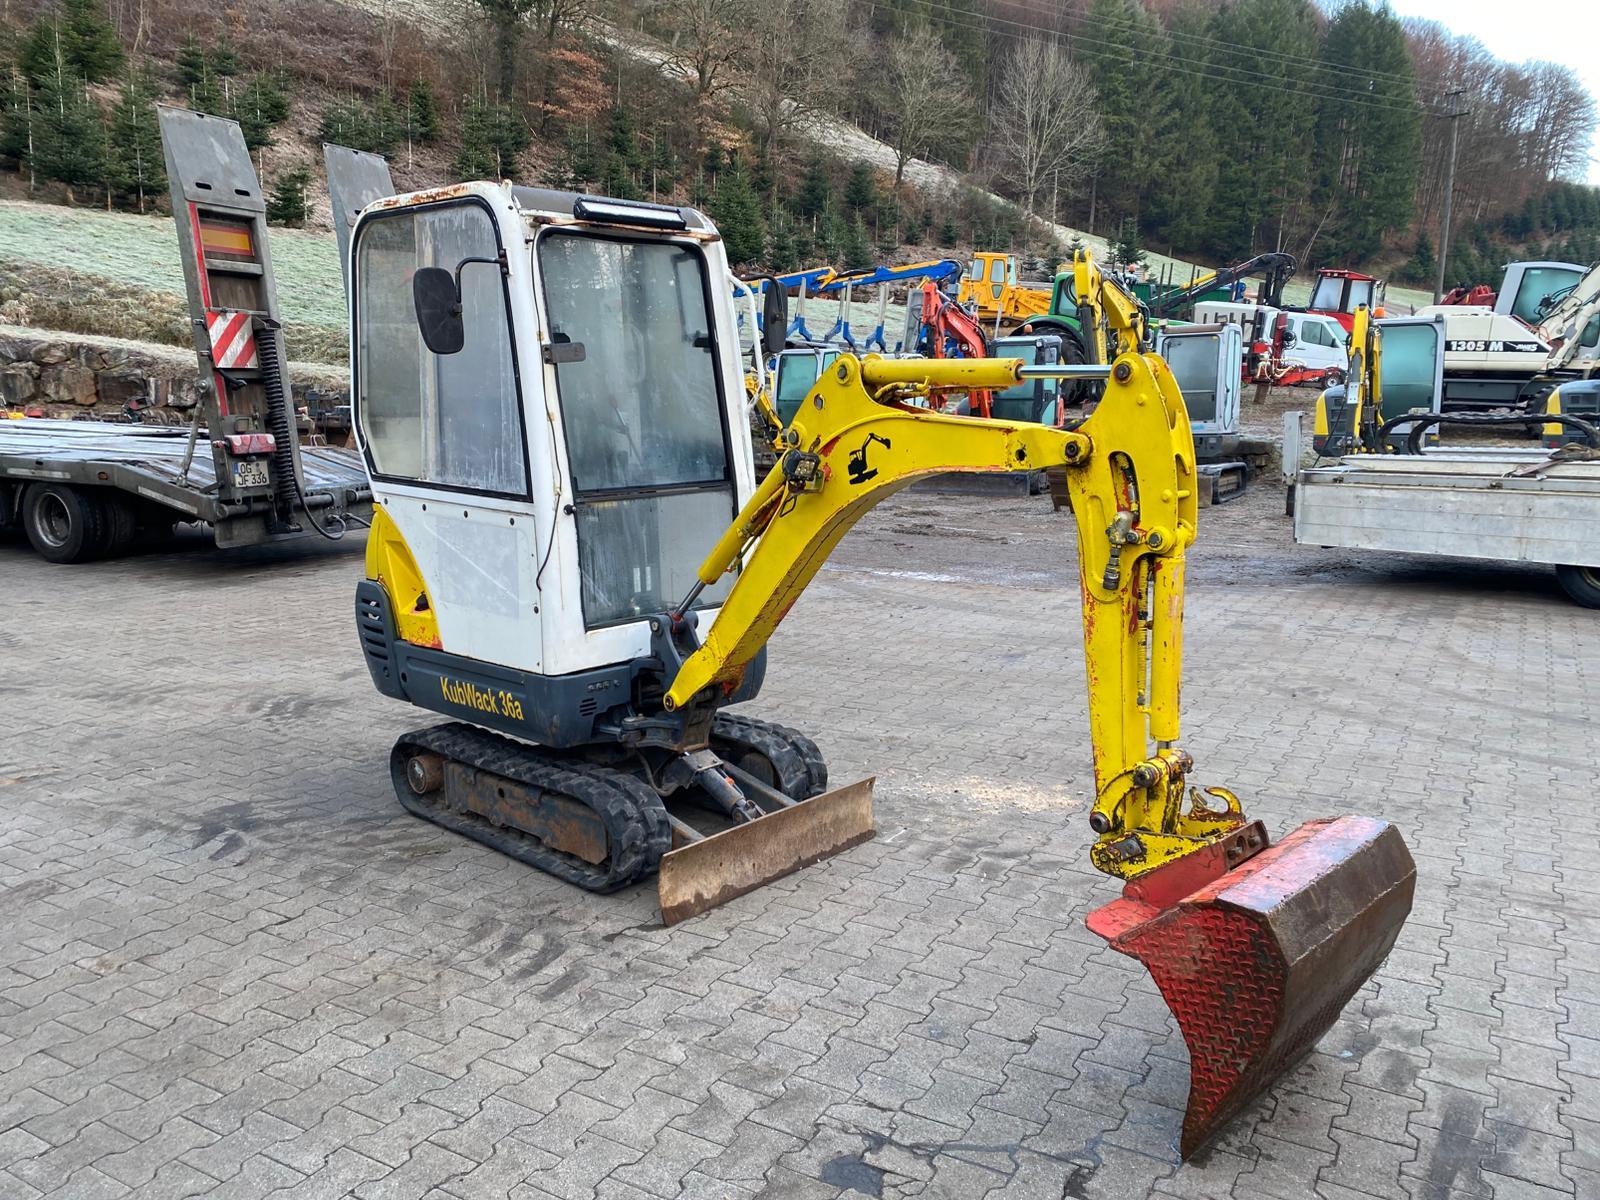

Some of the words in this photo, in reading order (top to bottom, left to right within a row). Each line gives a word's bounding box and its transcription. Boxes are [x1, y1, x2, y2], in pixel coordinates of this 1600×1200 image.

[1450, 341, 1485, 351] 1305
[1488, 341, 1503, 351] M
[240, 463, 252, 474] OG
[251, 473, 267, 484] 336
[439, 675, 500, 715] KubWack
[498, 690, 525, 721] 36a
